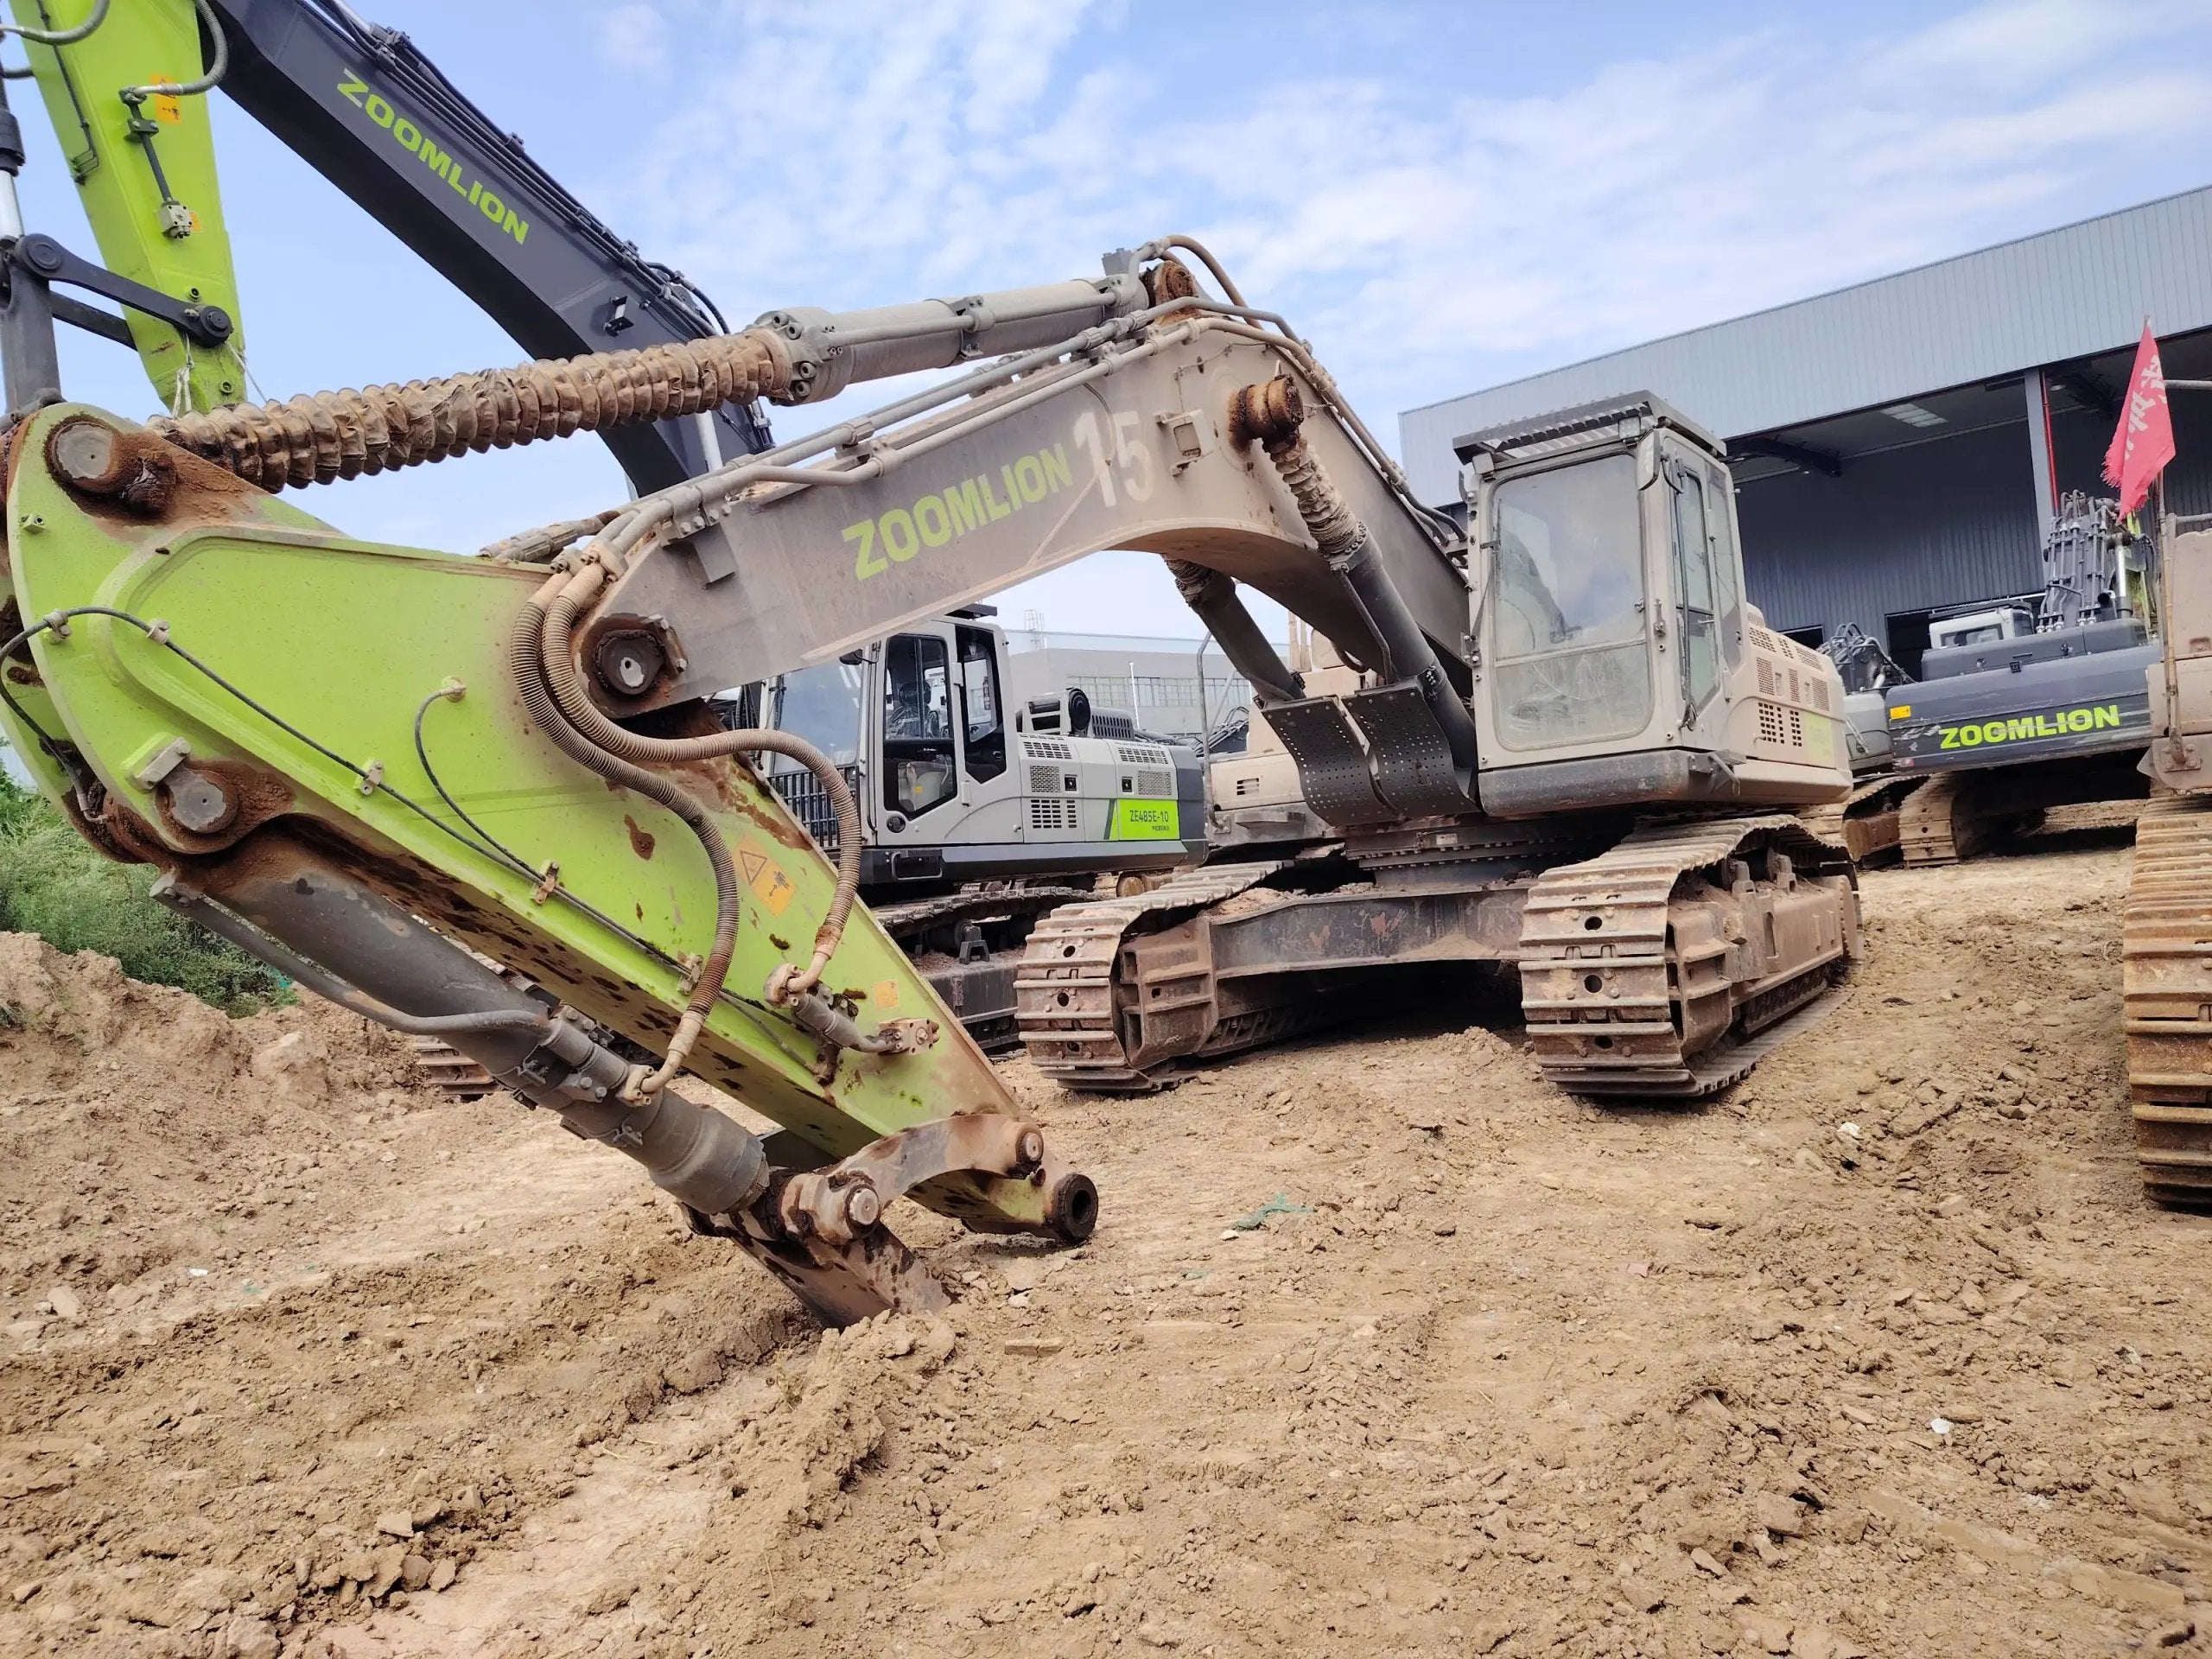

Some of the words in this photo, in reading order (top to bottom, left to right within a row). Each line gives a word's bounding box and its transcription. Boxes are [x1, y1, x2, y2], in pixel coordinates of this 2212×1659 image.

[337, 67, 529, 245] ZOOMLION
[1072, 410, 1154, 508] 15
[841, 442, 1074, 581] ZOOMLION
[1938, 704, 2120, 749] ZOOMLION
[1129, 810, 1169, 823] ZE485E-10
